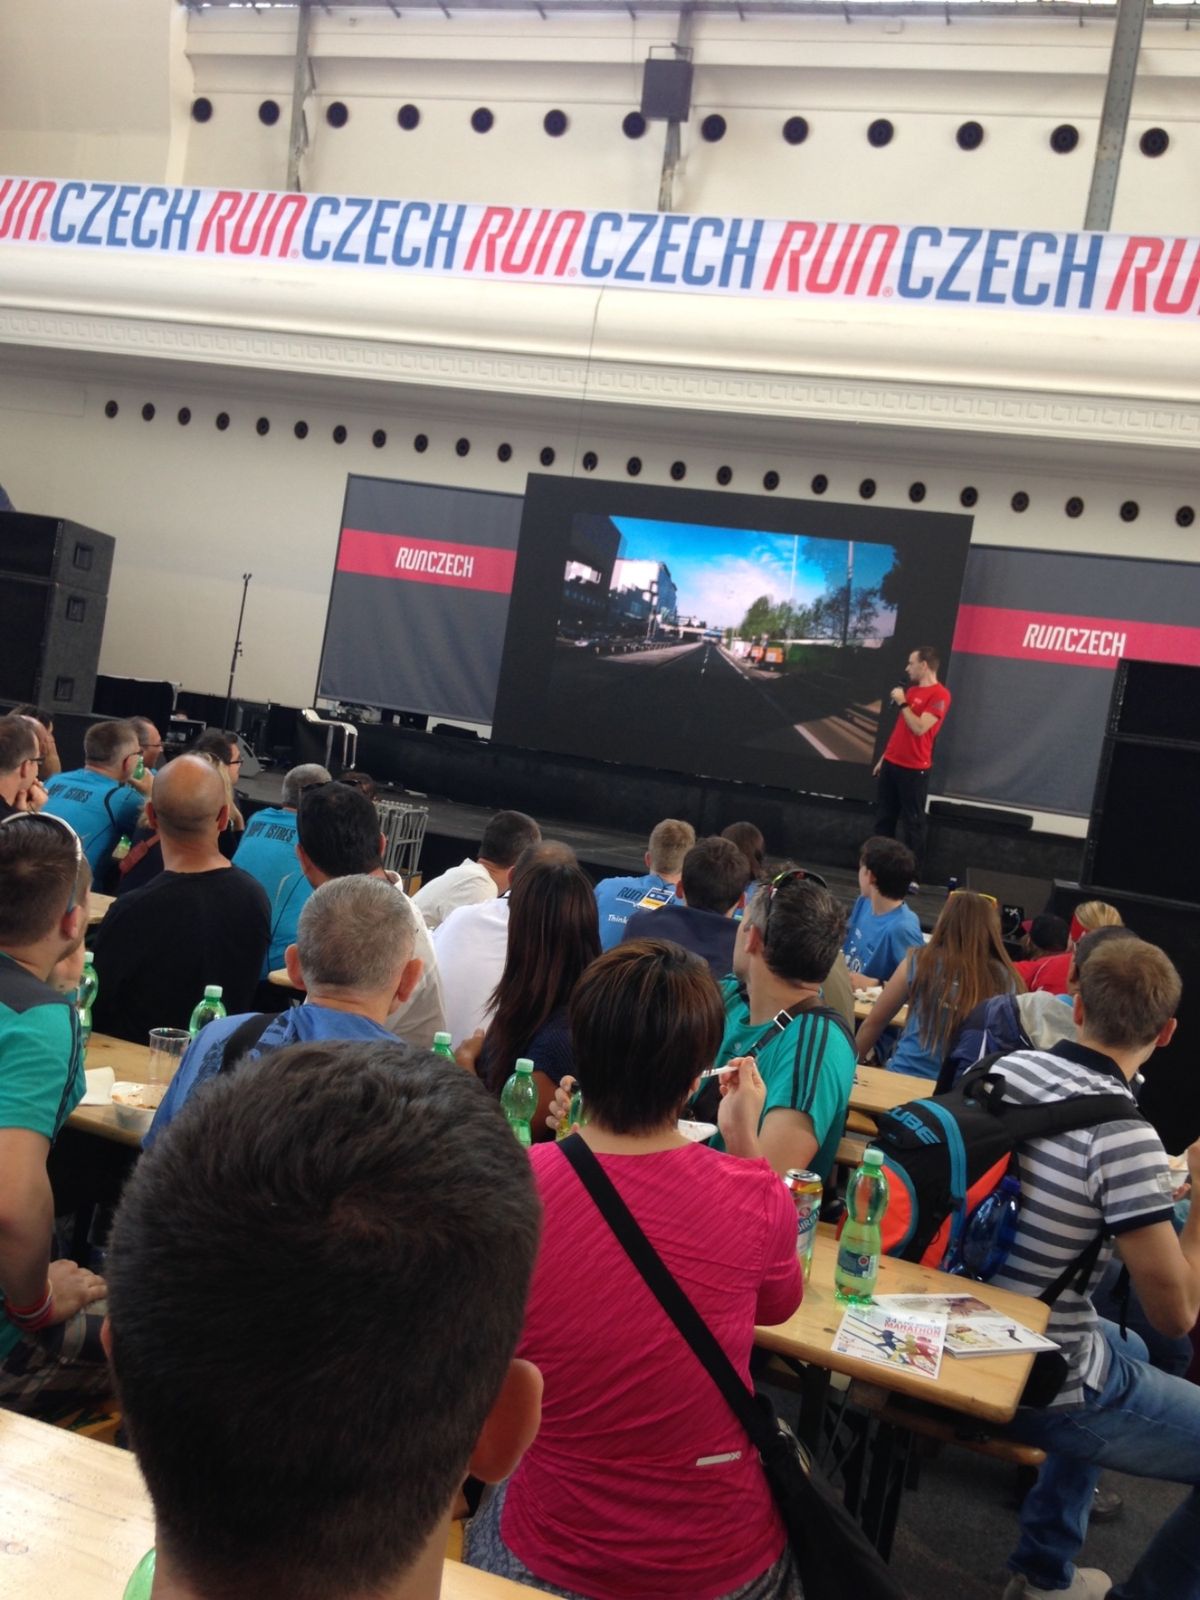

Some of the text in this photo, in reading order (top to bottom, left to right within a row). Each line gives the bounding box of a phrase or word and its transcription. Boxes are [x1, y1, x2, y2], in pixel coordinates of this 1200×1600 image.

[395, 547, 474, 578] RUNCZECH
[1022, 623, 1127, 658] RUNCZECH
[616, 886, 644, 901] RUN
